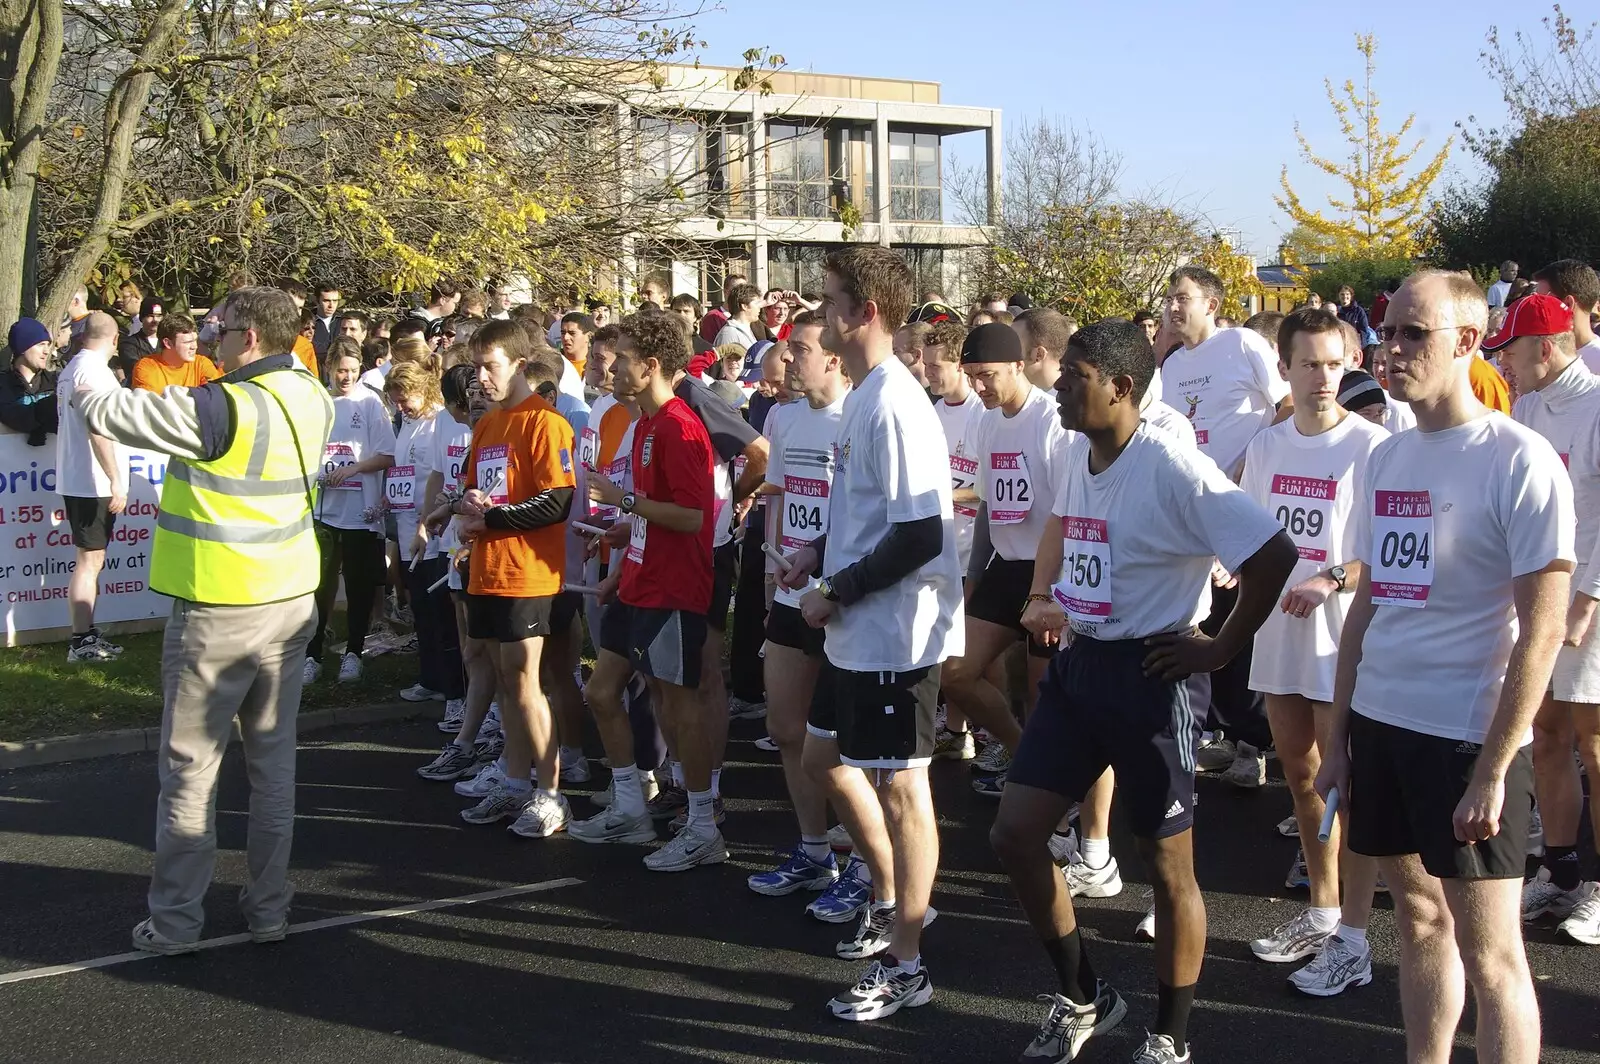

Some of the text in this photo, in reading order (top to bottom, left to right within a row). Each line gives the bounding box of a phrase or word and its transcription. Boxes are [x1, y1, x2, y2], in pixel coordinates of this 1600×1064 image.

[949, 461, 961, 470] UN
[997, 460, 1010, 469] FUN
[389, 482, 412, 498] 042
[788, 484, 821, 496] FUN RUN
[996, 478, 1029, 502] 012
[1280, 484, 1327, 498] FUN RUN
[789, 503, 822, 531] 034
[1388, 502, 1431, 516] FUN RUN
[1276, 505, 1324, 537] 069
[15, 532, 37, 549] at
[1068, 526, 1083, 538] FUN
[1380, 531, 1430, 569] 094
[22, 558, 76, 577] online
[126, 552, 146, 568] at
[1068, 552, 1101, 588] 150
[7, 586, 69, 602] CHILDRE
[105, 580, 144, 594] NEED
